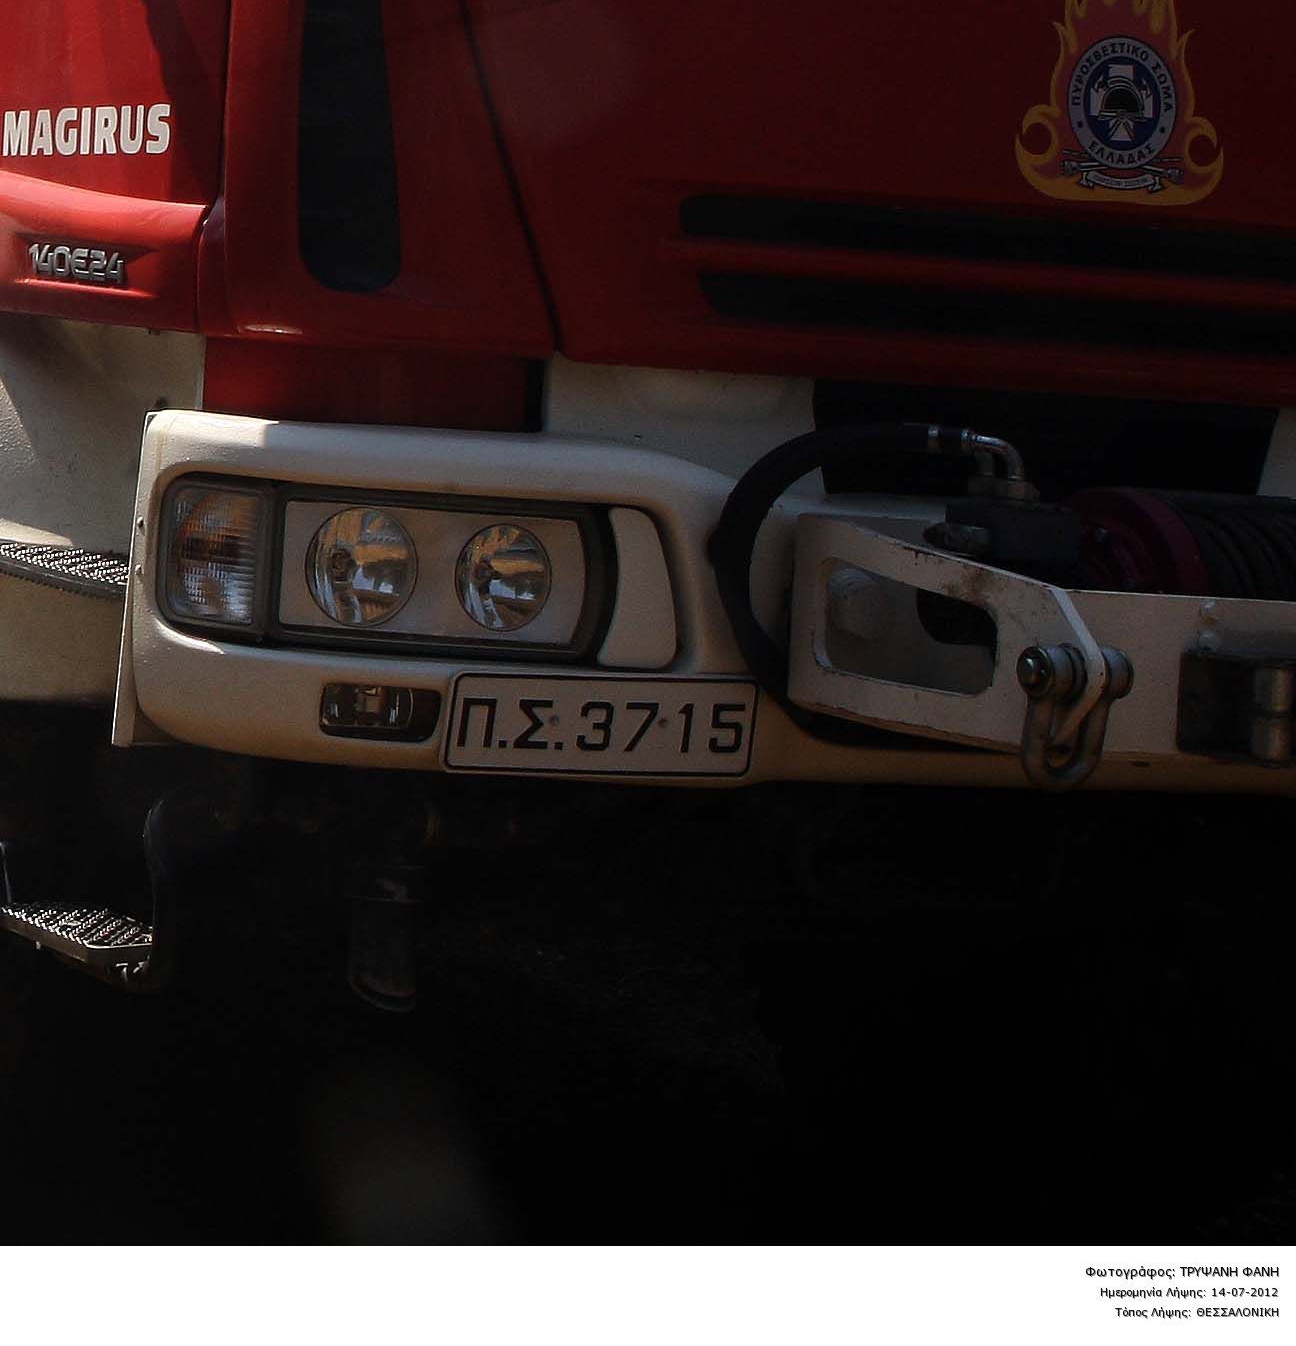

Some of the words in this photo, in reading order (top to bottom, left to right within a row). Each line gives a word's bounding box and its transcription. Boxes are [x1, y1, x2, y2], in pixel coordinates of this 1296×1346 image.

[1071, 41, 1151, 106] ΠΥΡΟΣΒΕΣΤΙΚΟ
[1151, 61, 1174, 112] ΣΩΜΑ
[2, 104, 171, 157] MAGIRUS
[1087, 140, 1155, 165] ΕΛΛΑΔΑΣ
[28, 243, 124, 283] 140E24
